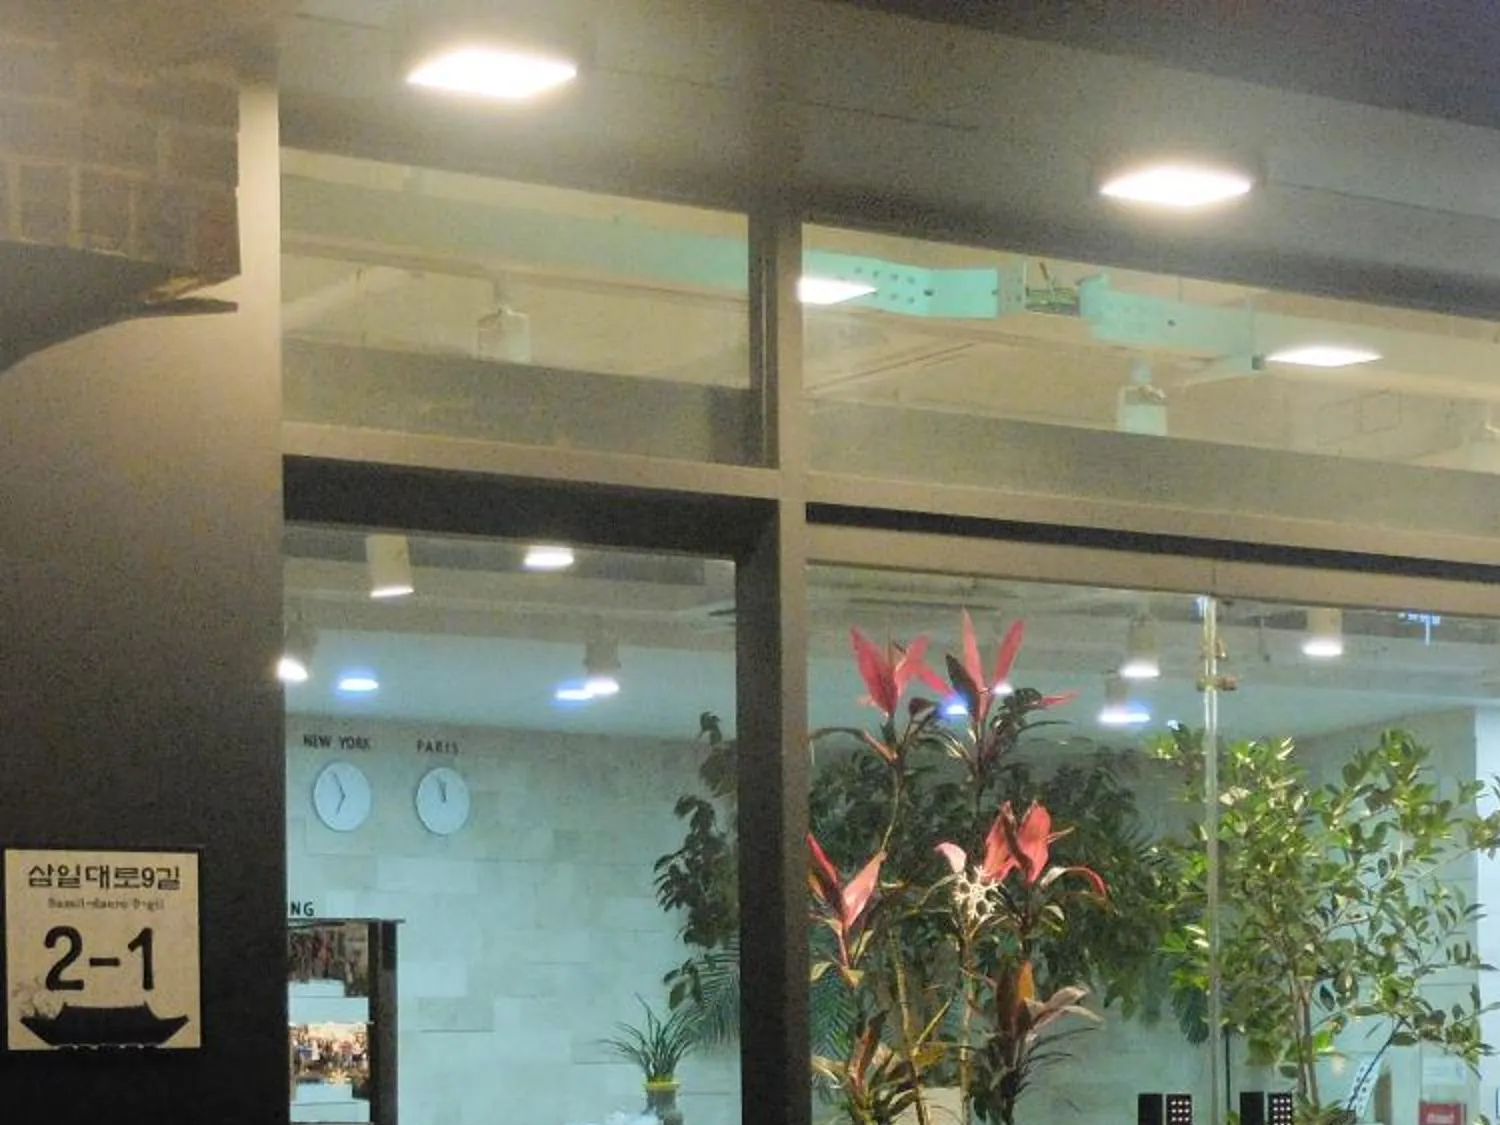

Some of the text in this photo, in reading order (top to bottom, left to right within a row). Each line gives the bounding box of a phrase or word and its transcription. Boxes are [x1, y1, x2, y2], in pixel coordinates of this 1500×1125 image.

[303, 733, 371, 751] NEW YORK
[416, 738, 460, 756] PARIS
[28, 863, 181, 891] 삼일대로9길
[44, 925, 155, 991] 2-1
